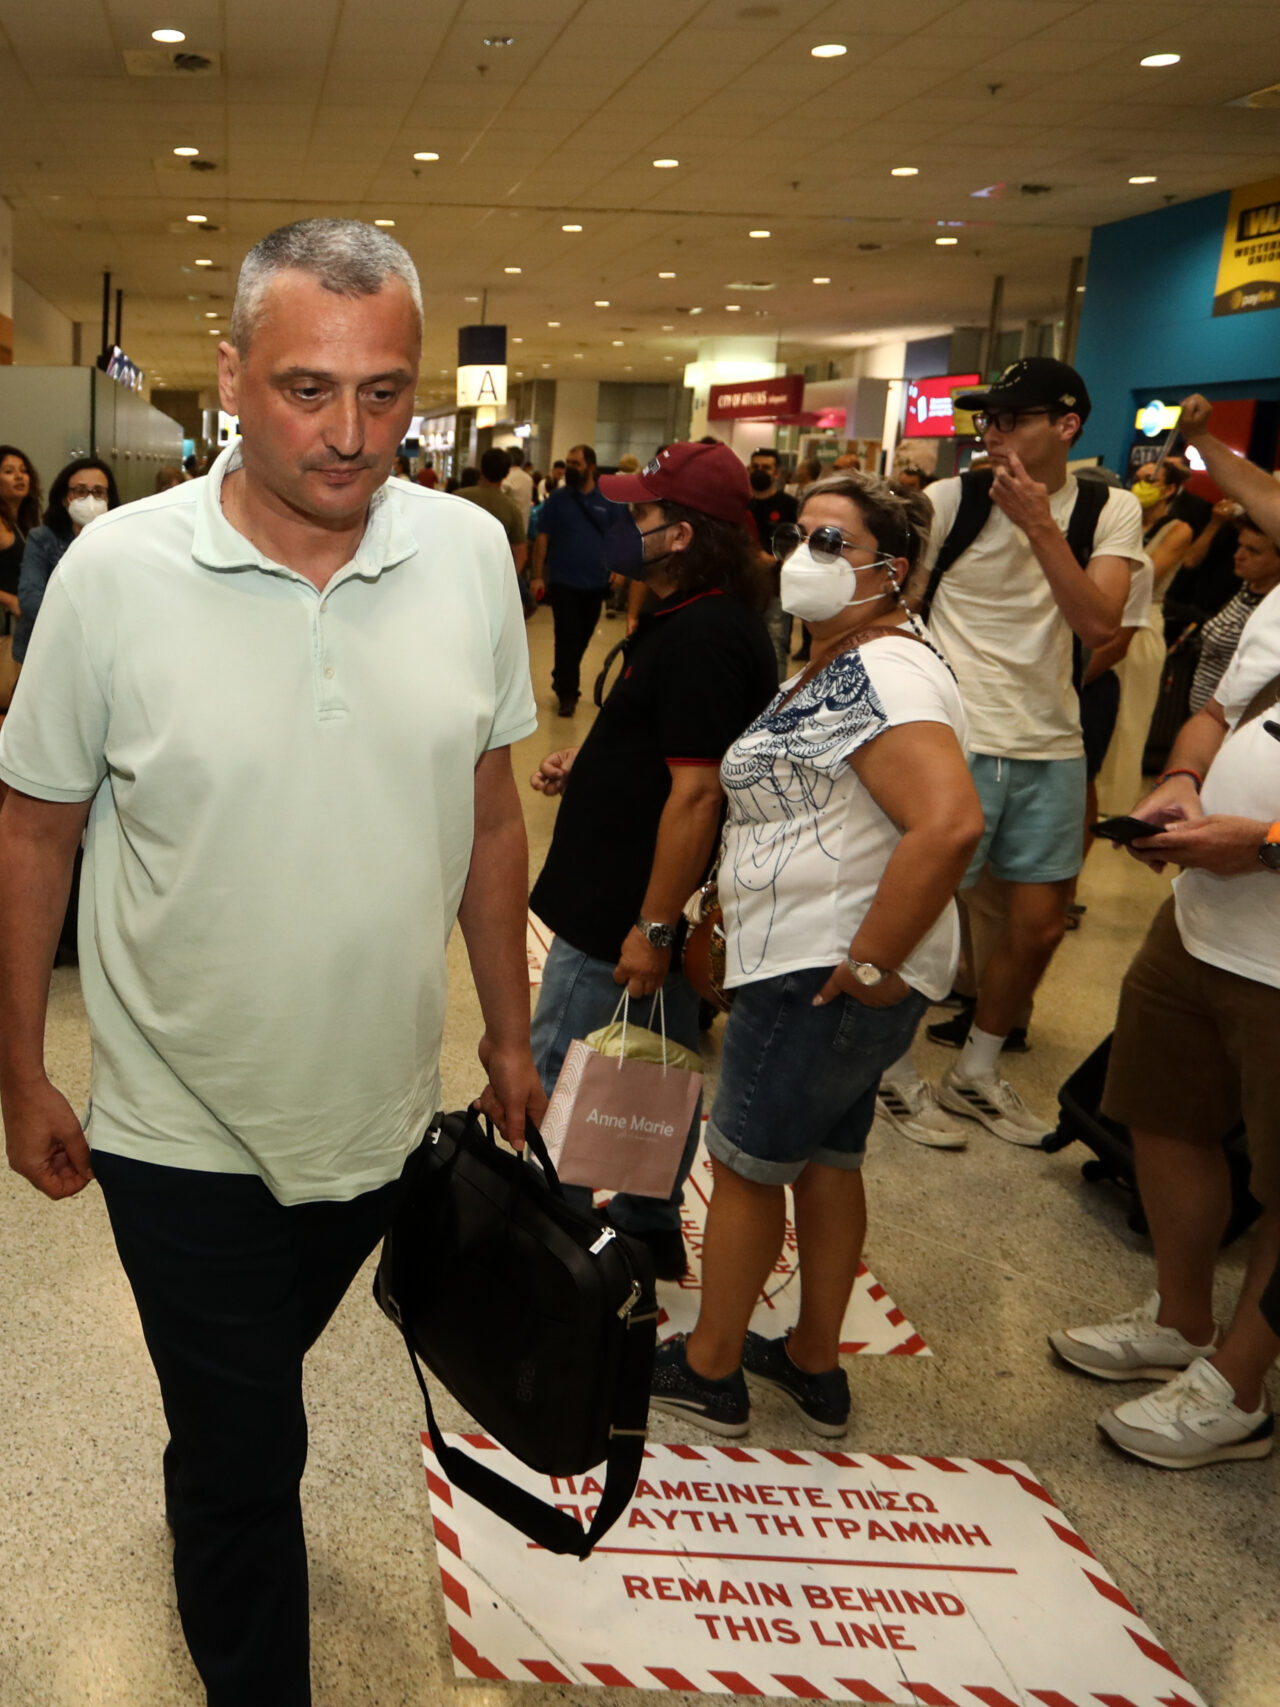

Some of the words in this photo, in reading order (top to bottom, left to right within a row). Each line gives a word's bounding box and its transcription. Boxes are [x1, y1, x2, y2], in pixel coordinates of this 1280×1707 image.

[1234, 241, 1280, 258] WESTER
[477, 370, 498, 401] A
[586, 1108, 627, 1129] Anne
[630, 1114, 674, 1137] Marie
[550, 1475, 832, 1508] ΠΑΑΜΕΙΝΕΤΕ
[837, 1488, 939, 1513] ΠΙΣΩ
[627, 1507, 739, 1534] ΑΥΤΗ
[745, 1513, 804, 1538] ΤΗ
[811, 1516, 992, 1547] ΓΡΑΜΜΗ
[622, 1574, 793, 1608] REMAIN
[800, 1584, 966, 1617] BEHIND
[695, 1613, 801, 1645] THIS
[809, 1620, 917, 1652] LINE
